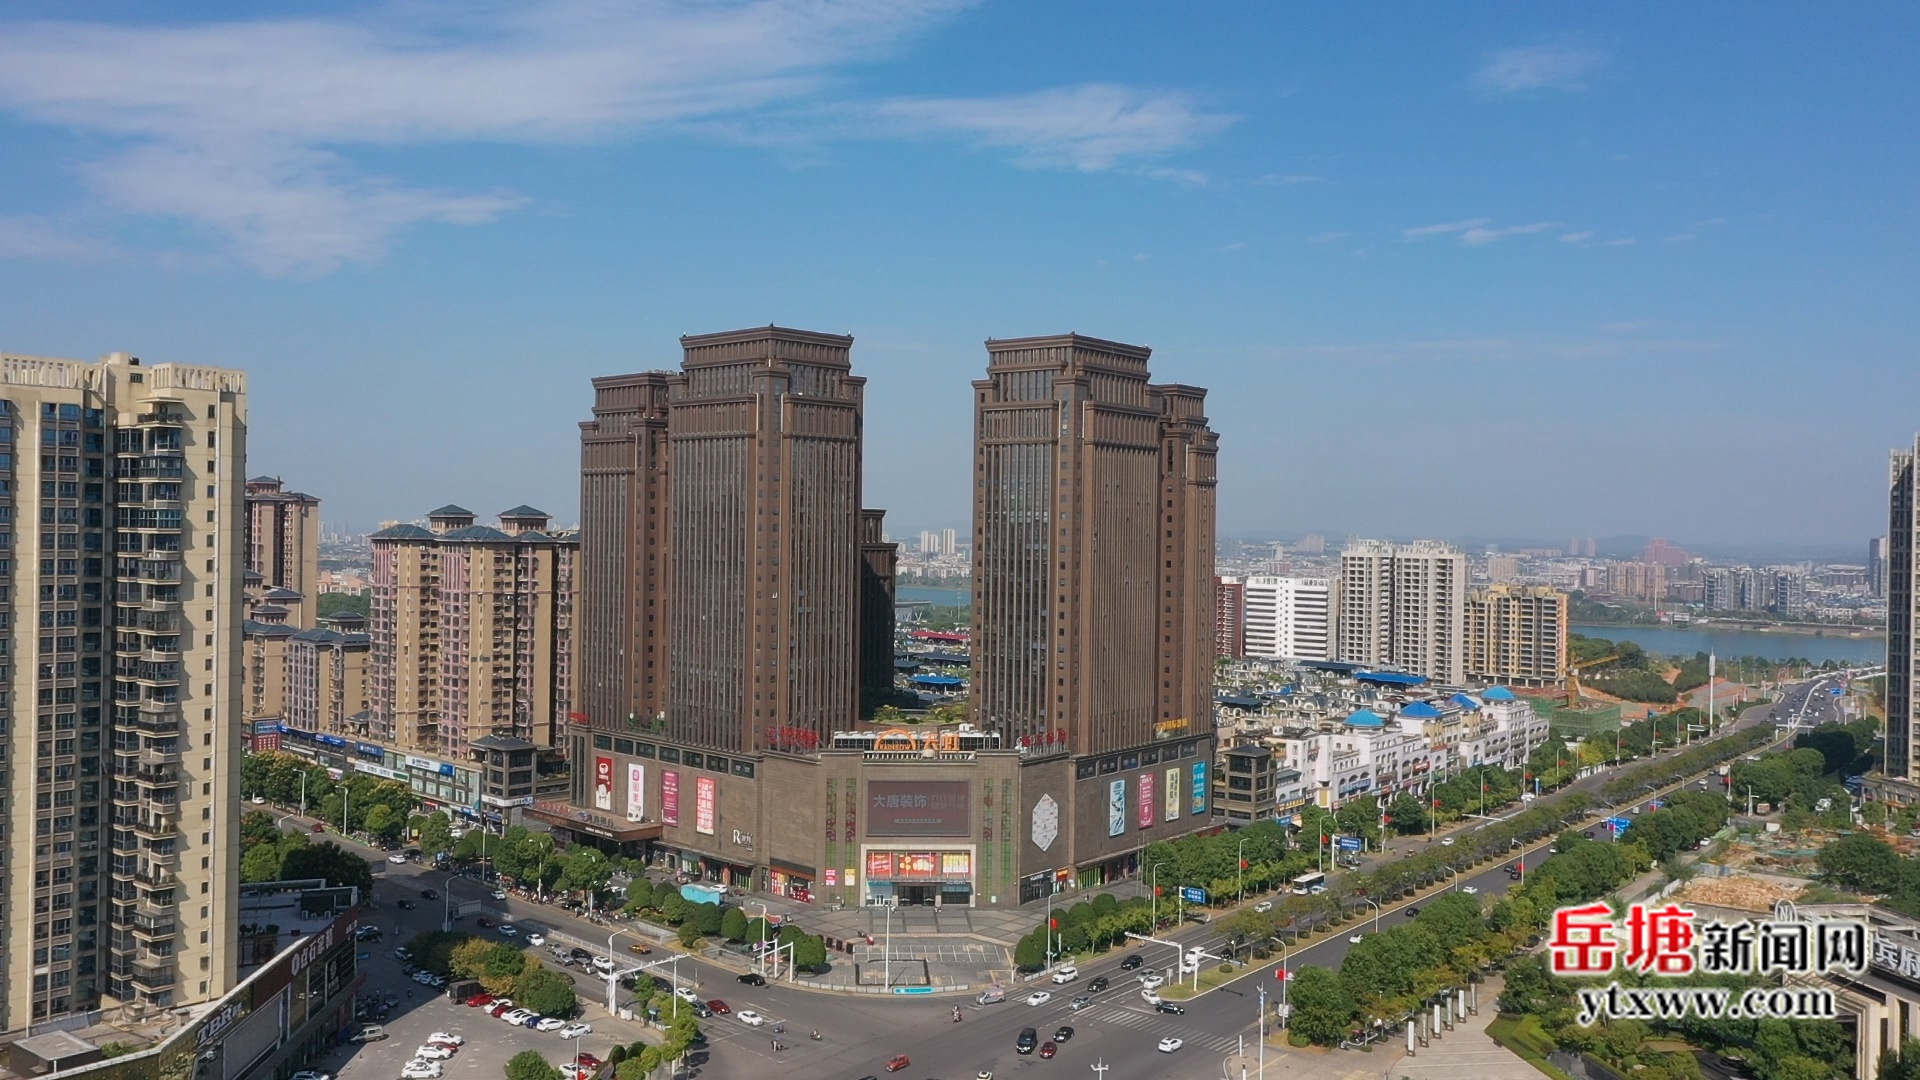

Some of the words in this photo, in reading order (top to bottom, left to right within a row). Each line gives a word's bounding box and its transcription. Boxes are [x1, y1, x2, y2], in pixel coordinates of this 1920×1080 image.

[880, 744, 911, 752] RAINBOW
[923, 733, 960, 752] 天虹
[872, 794, 928, 809] 大唐装饰
